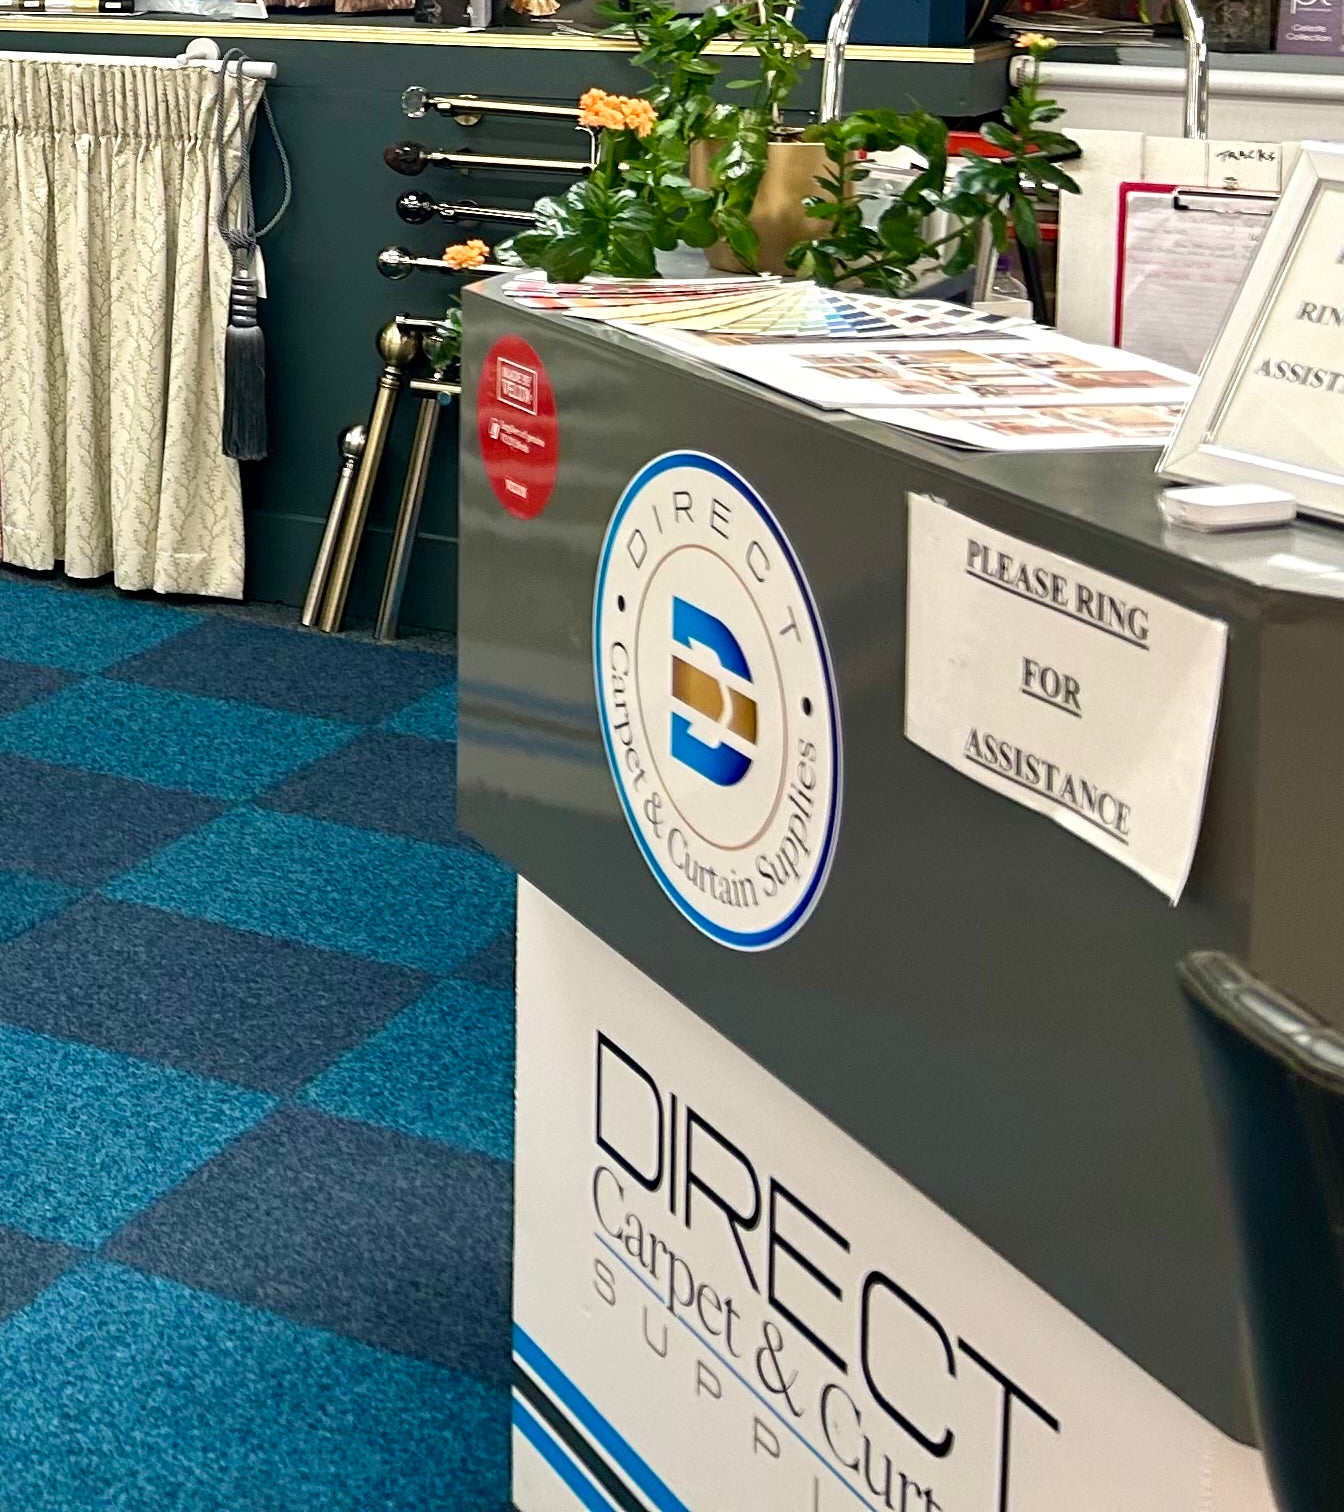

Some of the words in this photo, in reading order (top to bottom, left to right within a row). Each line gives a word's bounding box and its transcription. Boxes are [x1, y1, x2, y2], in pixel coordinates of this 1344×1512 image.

[1296, 299, 1344, 329] RIN
[1253, 357, 1344, 394] ASSIST
[626, 489, 803, 646] DIRECT
[965, 538, 1070, 609] PLEASE
[1074, 584, 1150, 644] RING
[1021, 656, 1083, 712] FOR
[609, 640, 647, 785] Carpet
[642, 790, 666, 840] &
[666, 825, 760, 909] Curtain
[755, 737, 818, 899] Supplies
[963, 726, 1132, 838] ASSISTANCE
[593, 1165, 742, 1360] Carpet
[755, 1319, 804, 1419] &
[595, 1029, 1061, 1512] DIRECT
